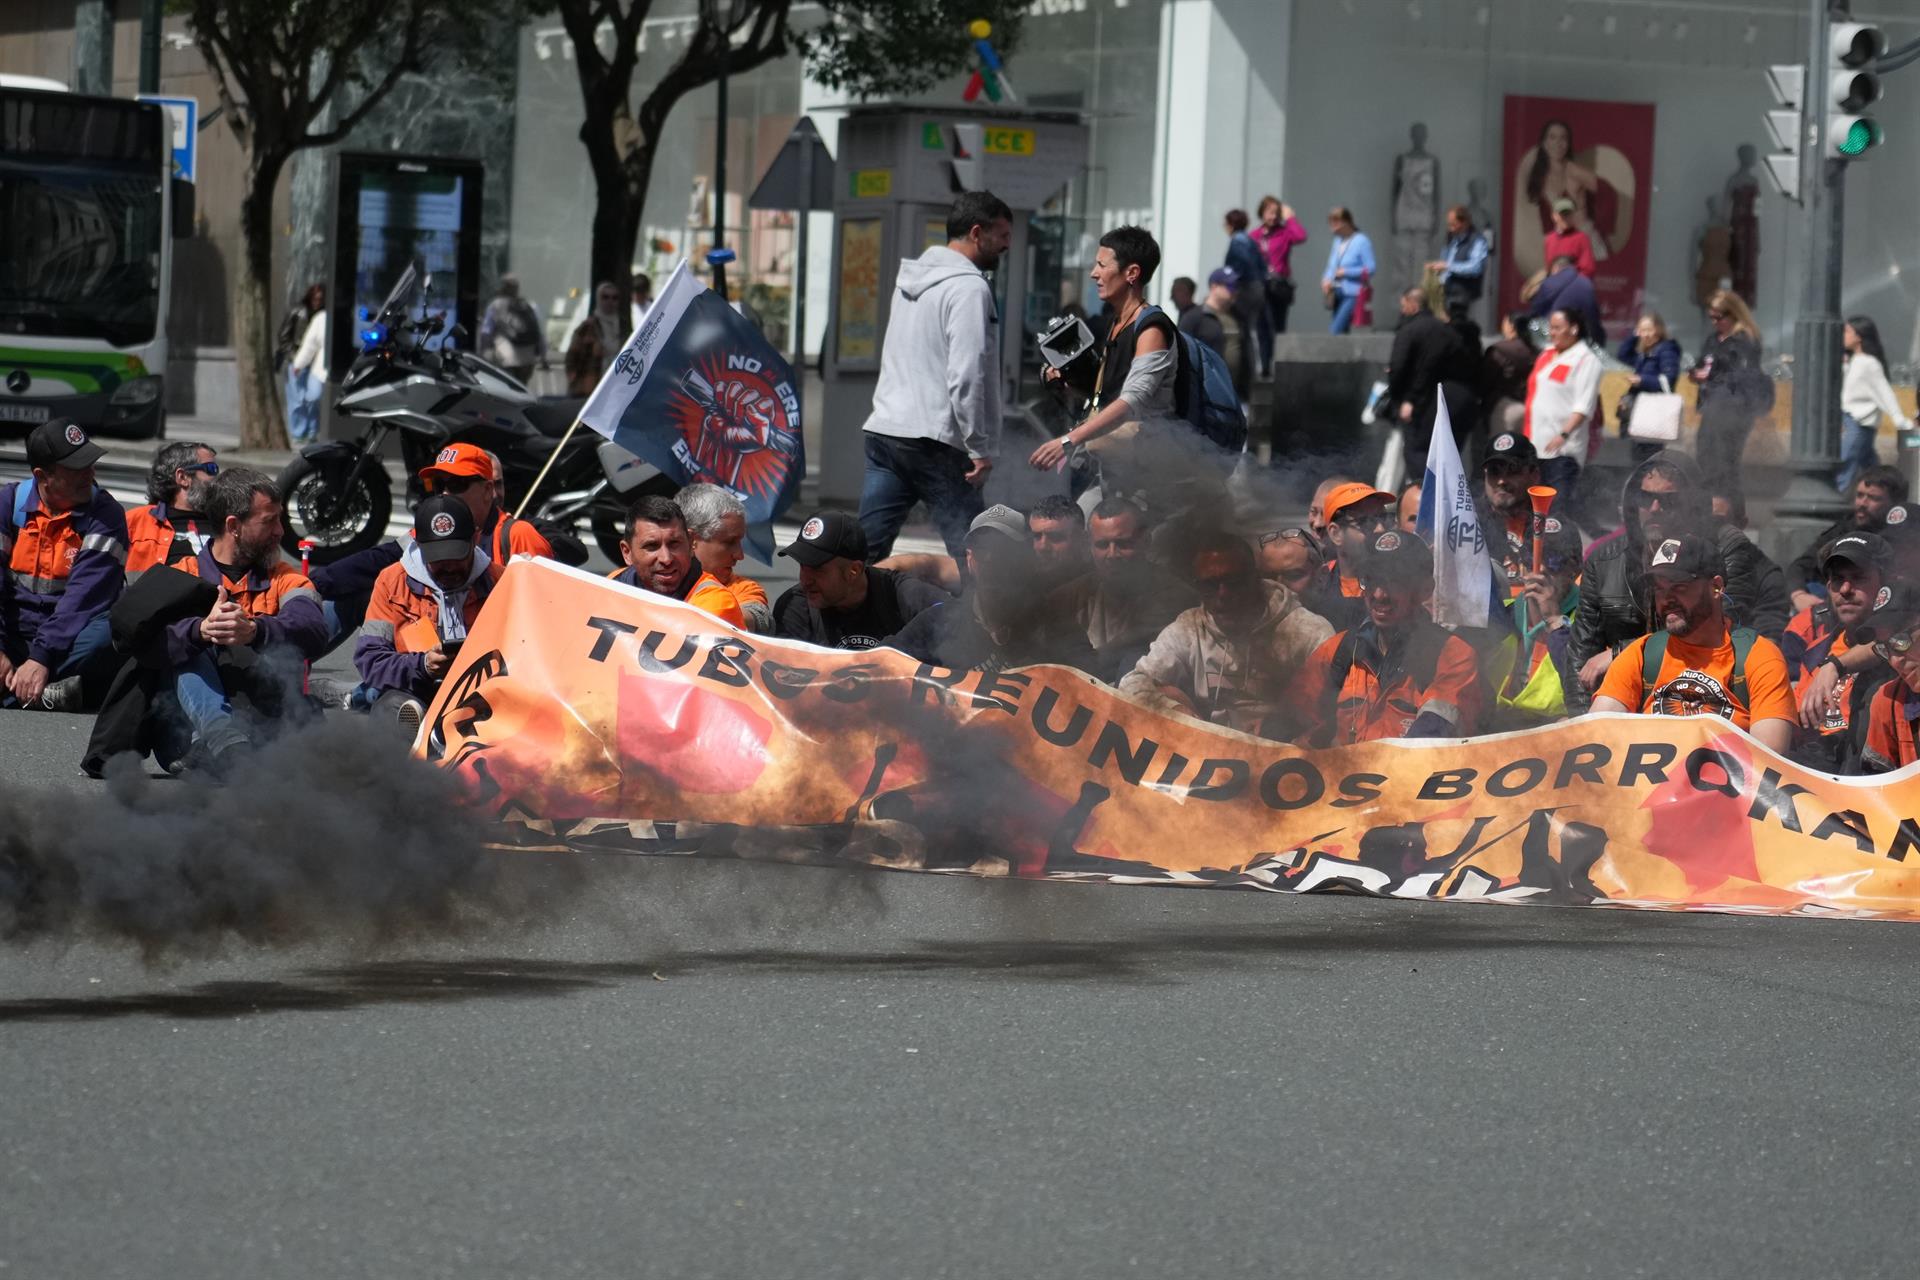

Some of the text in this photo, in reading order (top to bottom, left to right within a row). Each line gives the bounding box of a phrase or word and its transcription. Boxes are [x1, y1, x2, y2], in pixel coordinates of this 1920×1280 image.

[728, 355, 800, 427] NO ERE
[1456, 473, 1465, 511] TUBOS
[586, 616, 881, 704] TUBOS
[911, 662, 1390, 811] REUNIDOS
[1676, 683, 1689, 691] NO
